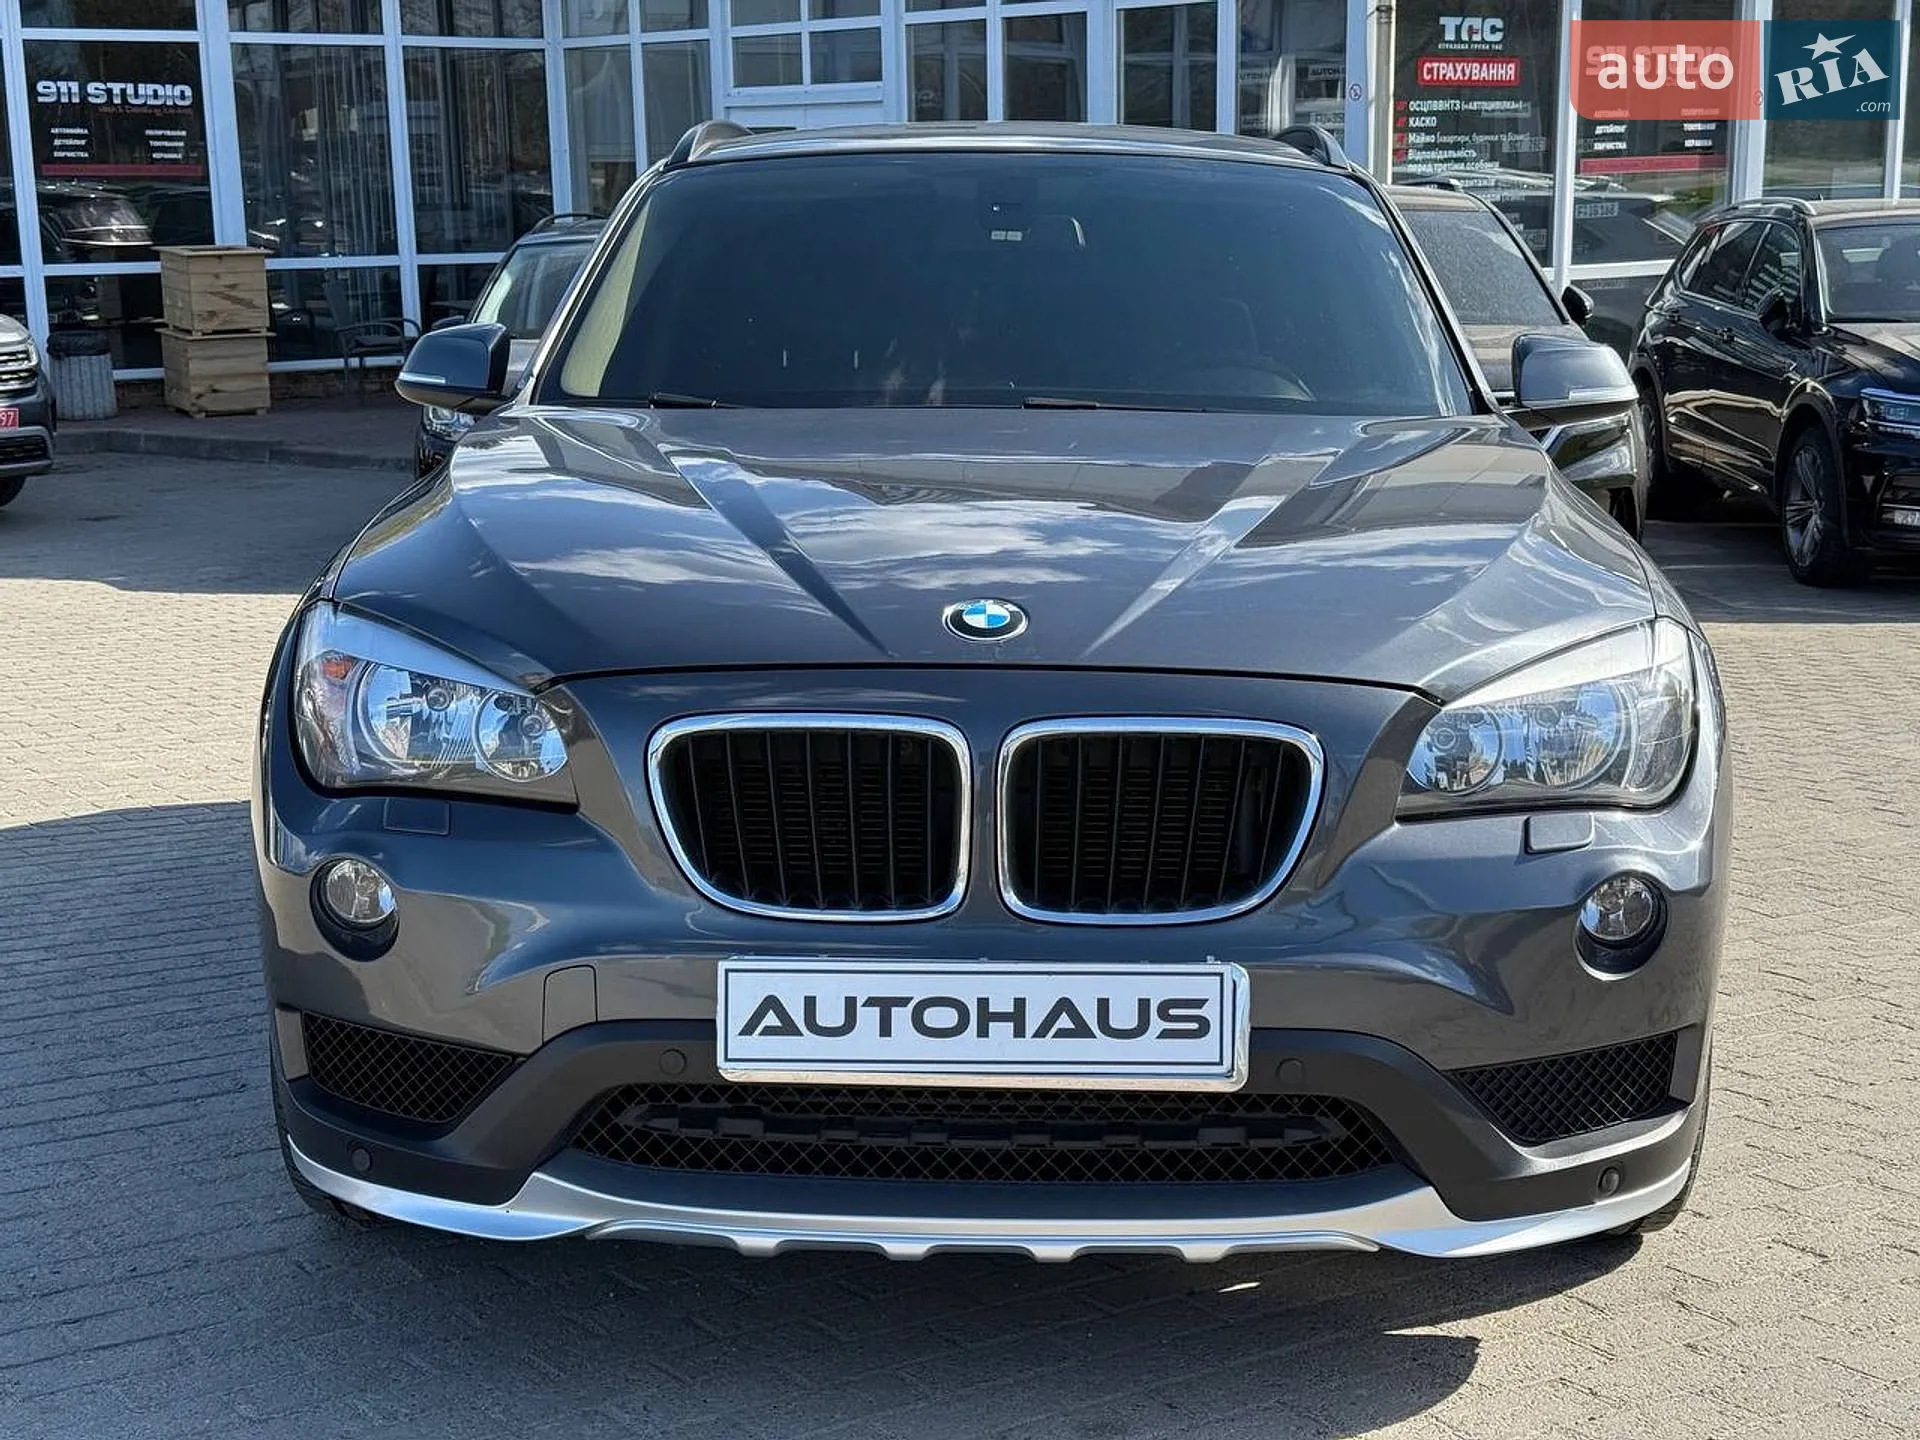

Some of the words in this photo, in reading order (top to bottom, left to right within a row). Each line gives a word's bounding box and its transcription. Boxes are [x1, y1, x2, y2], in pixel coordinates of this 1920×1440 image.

[1423, 62, 1516, 81] СТРАХУВАННЯ
[36, 80, 81, 103] 911
[86, 82, 193, 106] STUDIO
[1408, 117, 1437, 128] КАСКО
[1408, 133, 1436, 144] Майно
[738, 994, 1211, 1039] AUTOHAUS
